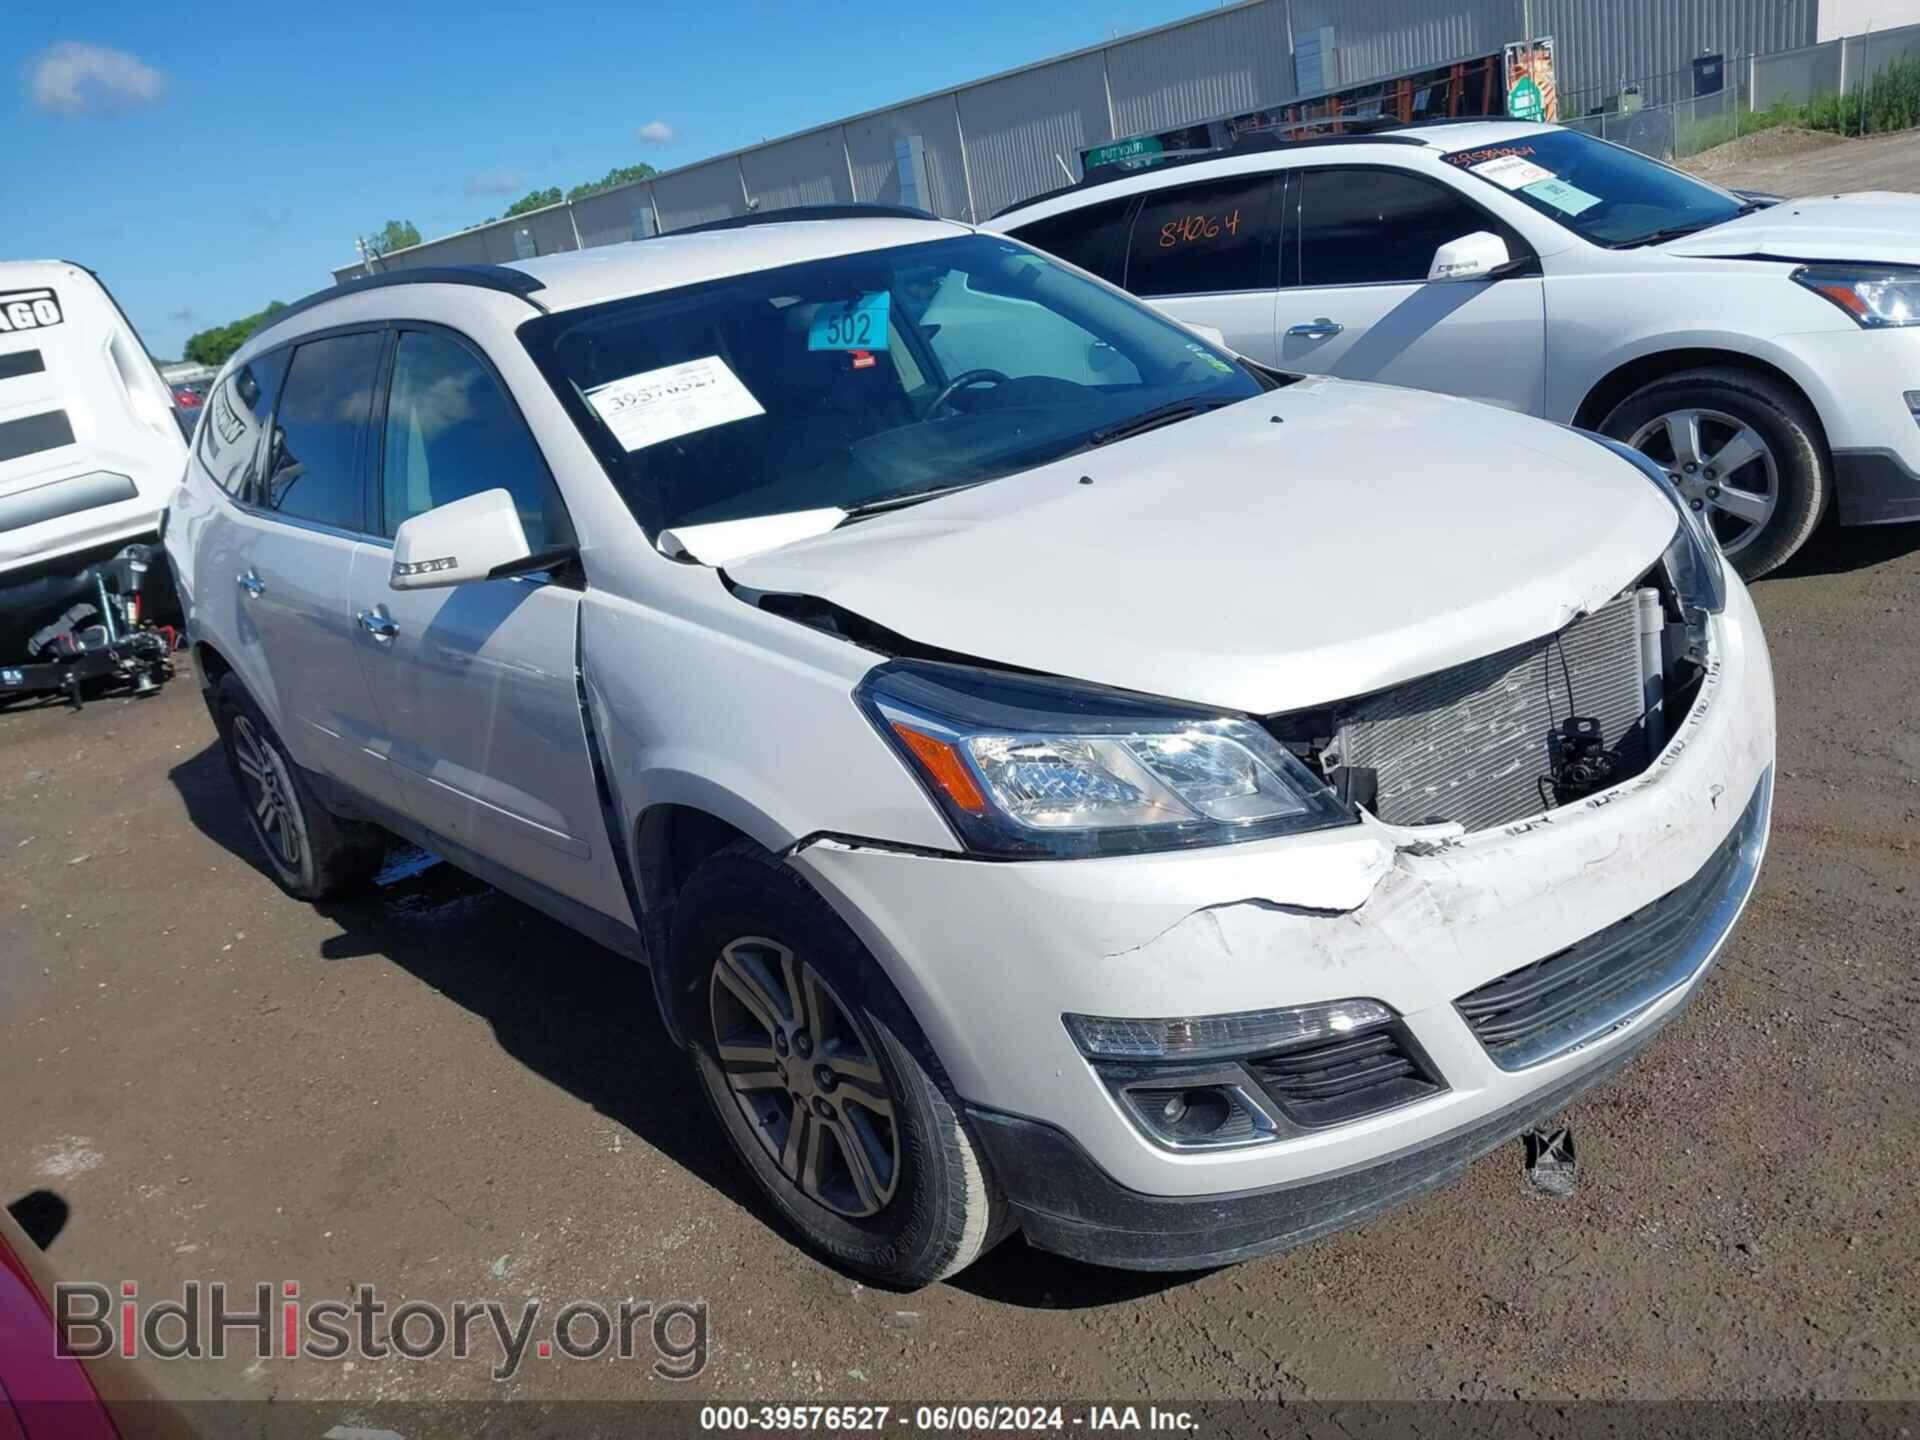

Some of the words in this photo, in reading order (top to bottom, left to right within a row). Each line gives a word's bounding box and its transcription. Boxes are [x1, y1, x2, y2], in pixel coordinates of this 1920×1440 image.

[1101, 147, 1119, 160] PUT
[1119, 142, 1144, 156] YOUR
[1160, 209, 1240, 247] 84064
[827, 314, 871, 345] 502
